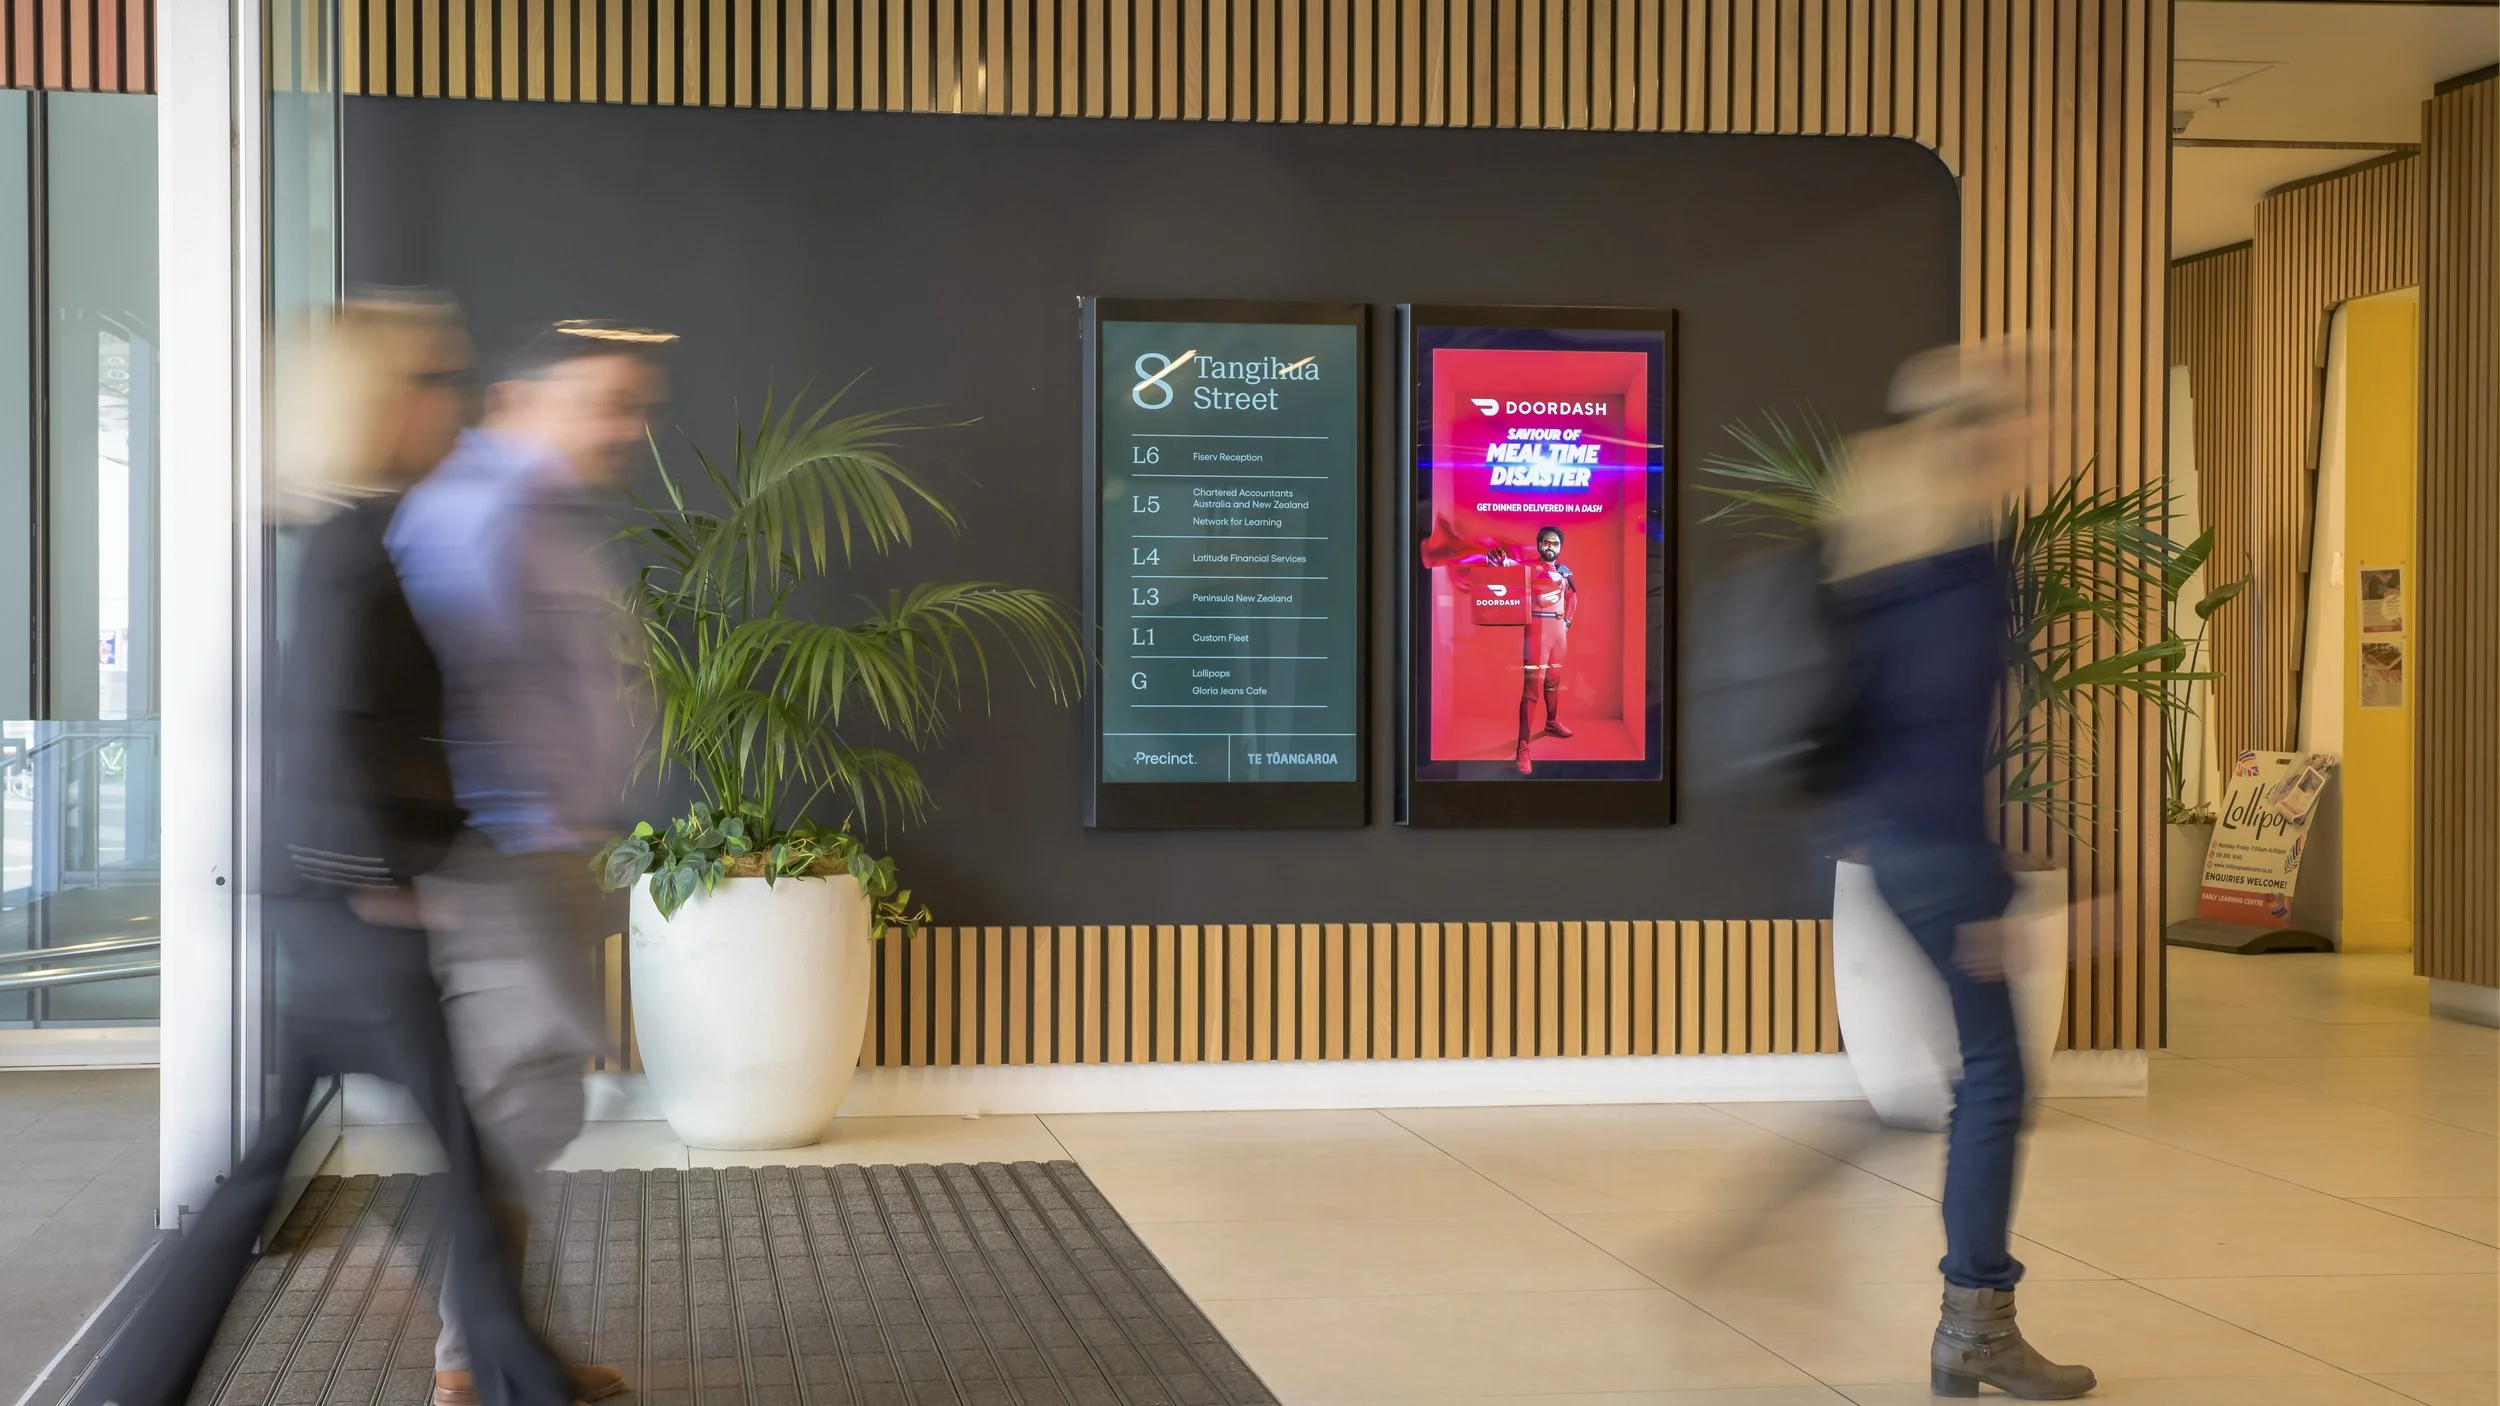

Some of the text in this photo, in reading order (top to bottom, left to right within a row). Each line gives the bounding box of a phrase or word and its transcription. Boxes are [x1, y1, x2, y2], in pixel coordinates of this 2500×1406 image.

[1193, 356, 1320, 384] Tangihua
[1132, 352, 1173, 410] 8
[1194, 387, 1279, 411] Street
[1506, 401, 1607, 416] DOORDASH
[1507, 428, 1581, 441] SAVIOUR OF
[1132, 446, 1159, 464] L6
[1193, 452, 1263, 463] Fiserv Reception
[1490, 467, 1592, 487] DISASTER
[1193, 488, 1293, 497] Chartered Accountants
[1132, 496, 1160, 513] L5
[1193, 500, 1309, 509] Australia and New Zealand
[1477, 503, 1603, 513] GET DINNER DELIVERED IN A DASH
[1193, 517, 1282, 528] Network for Learning
[1132, 548, 1160, 565] L4
[1192, 553, 1306, 563] Latitude Financial Services
[1132, 588, 1159, 605] L3
[1192, 594, 1292, 603] Peninsula New Zealand
[1132, 628, 1155, 645] L1
[1192, 633, 1249, 642] Custom Fleet
[1131, 672, 1147, 689] G
[1192, 669, 1230, 679] Lollipops
[1192, 686, 1267, 695] Gloria Jeans Cafe
[1248, 753, 1262, 765] TE
[2222, 783, 2306, 840] Lollipop
[2205, 872, 2288, 889] ENQUIRIES WELCOME!
[2202, 892, 2265, 907] EARLY LEARNING CENTRE
